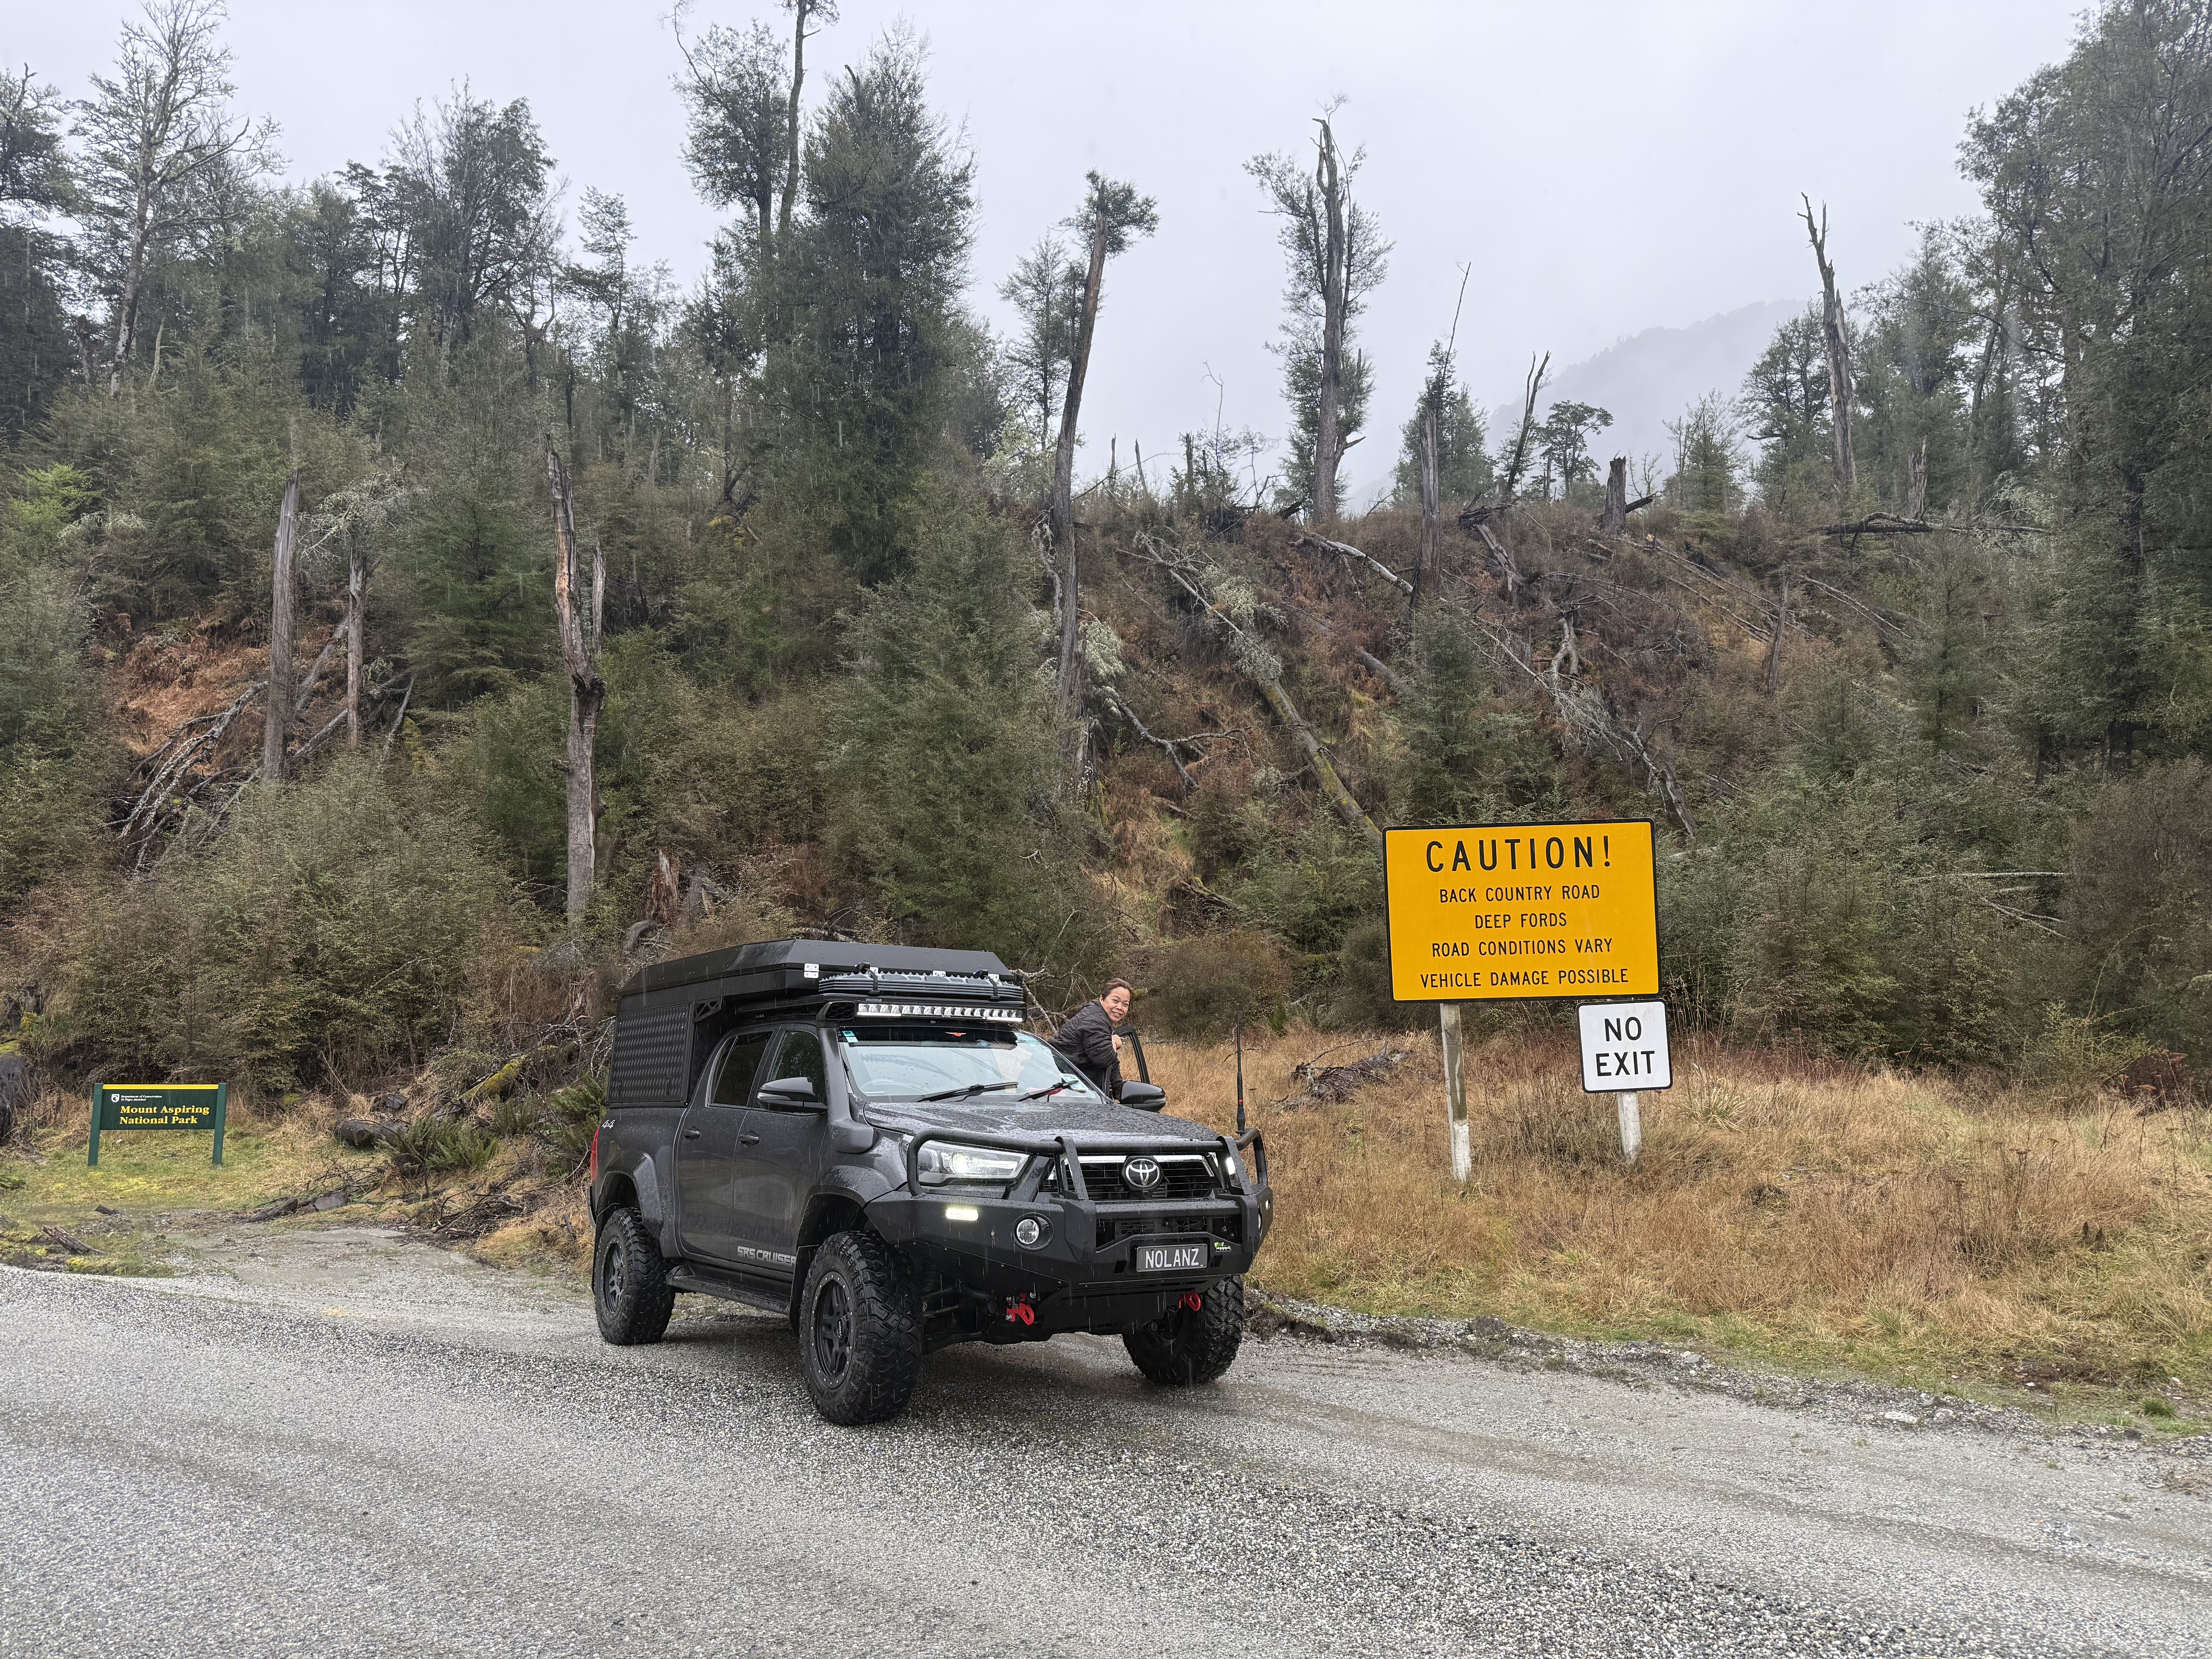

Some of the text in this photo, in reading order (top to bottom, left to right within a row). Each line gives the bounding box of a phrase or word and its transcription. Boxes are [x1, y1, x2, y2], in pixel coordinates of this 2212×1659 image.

[1426, 835, 1611, 872] CAUTION!
[1440, 884, 1599, 903] BACK COUNTRY ROAD
[1475, 912, 1567, 929] DEEP FORDS
[1432, 938, 1612, 957] ROAD CONDITIONS VARY
[1420, 969, 1628, 988] VEHICLE DAMAGE POSSIBLE
[1604, 1017, 1642, 1042] NO
[1595, 1050, 1655, 1077] EXIT
[160, 1105, 210, 1115] Aspiring
[120, 1116, 198, 1124] National Park
[756, 1249, 797, 1267] CRUISER
[1146, 1248, 1199, 1269] NOLANZ
